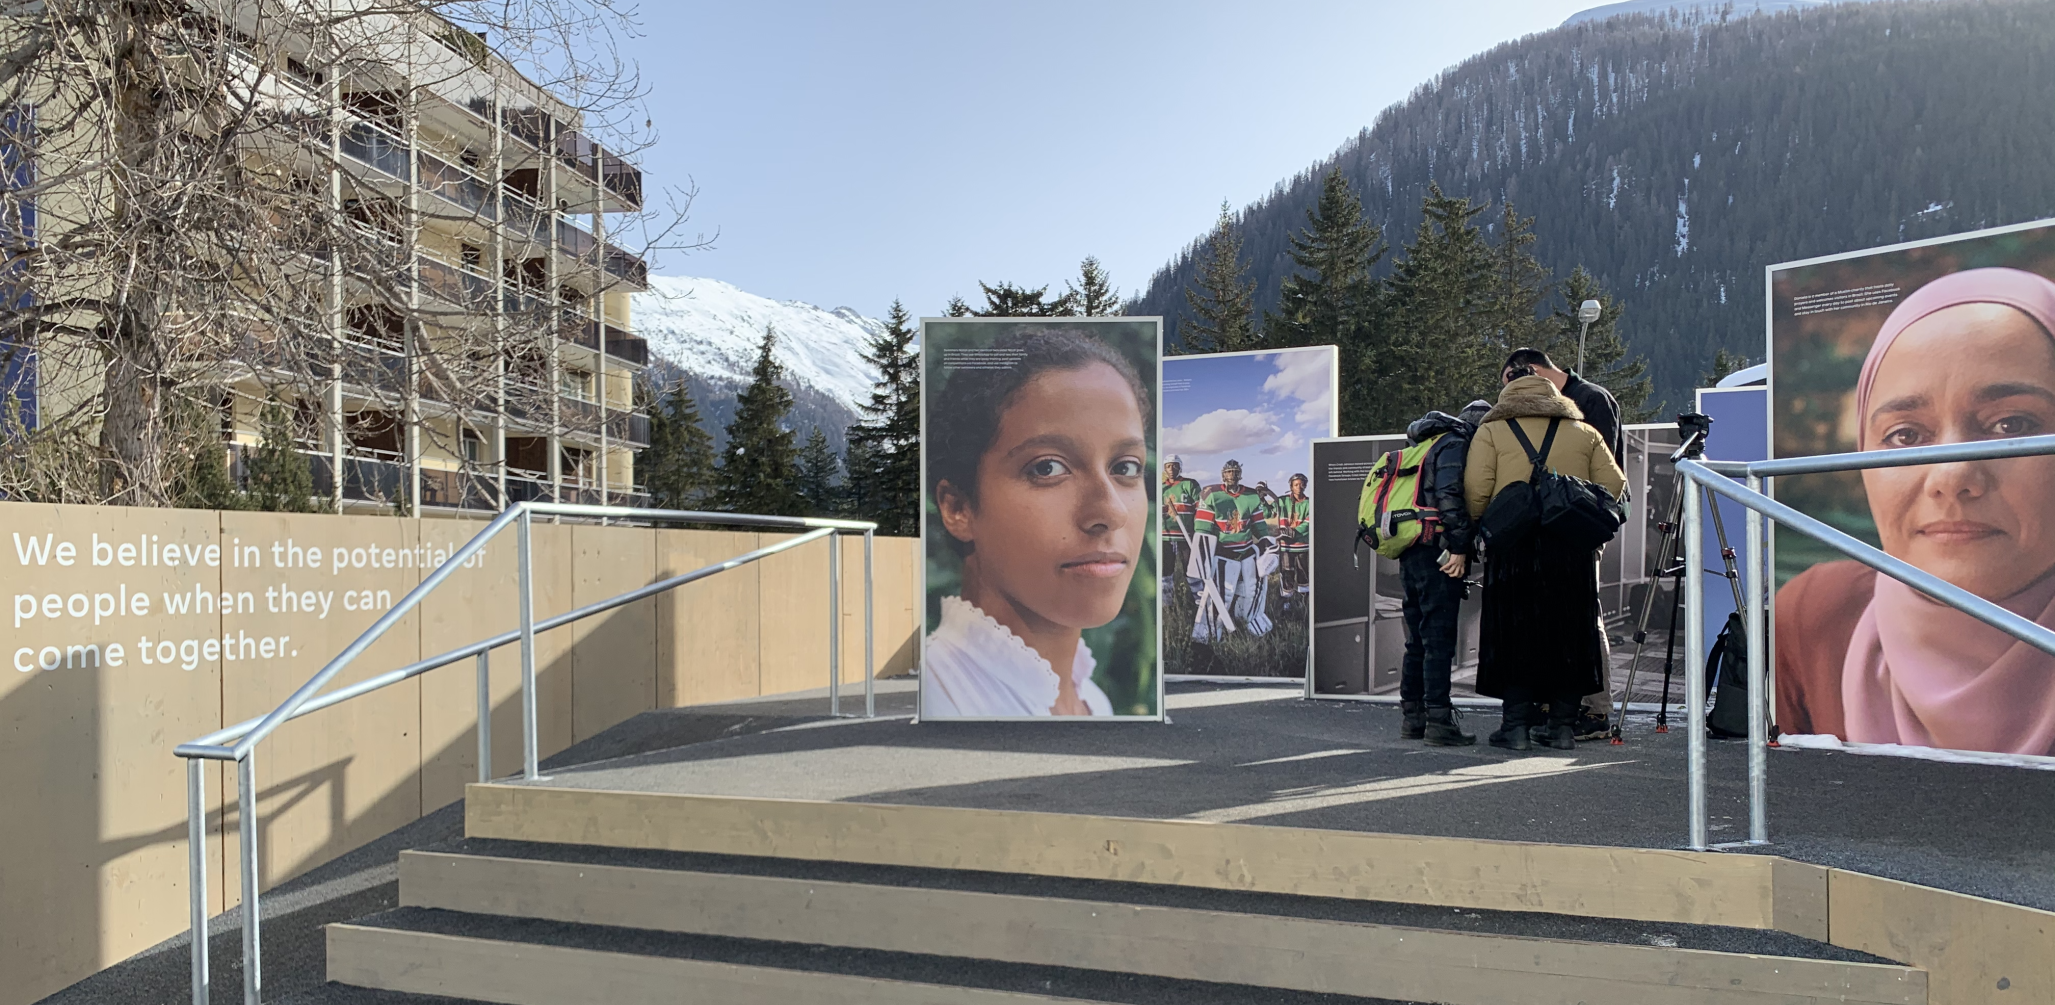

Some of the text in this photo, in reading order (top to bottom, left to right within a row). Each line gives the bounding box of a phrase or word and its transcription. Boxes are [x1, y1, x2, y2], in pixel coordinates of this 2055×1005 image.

[13, 532, 77, 566] We
[92, 534, 221, 567] believe
[233, 538, 261, 568] in
[271, 538, 322, 569] the
[333, 542, 454, 574] potential
[14, 583, 391, 627] people when they can
[13, 630, 299, 673] come together.
